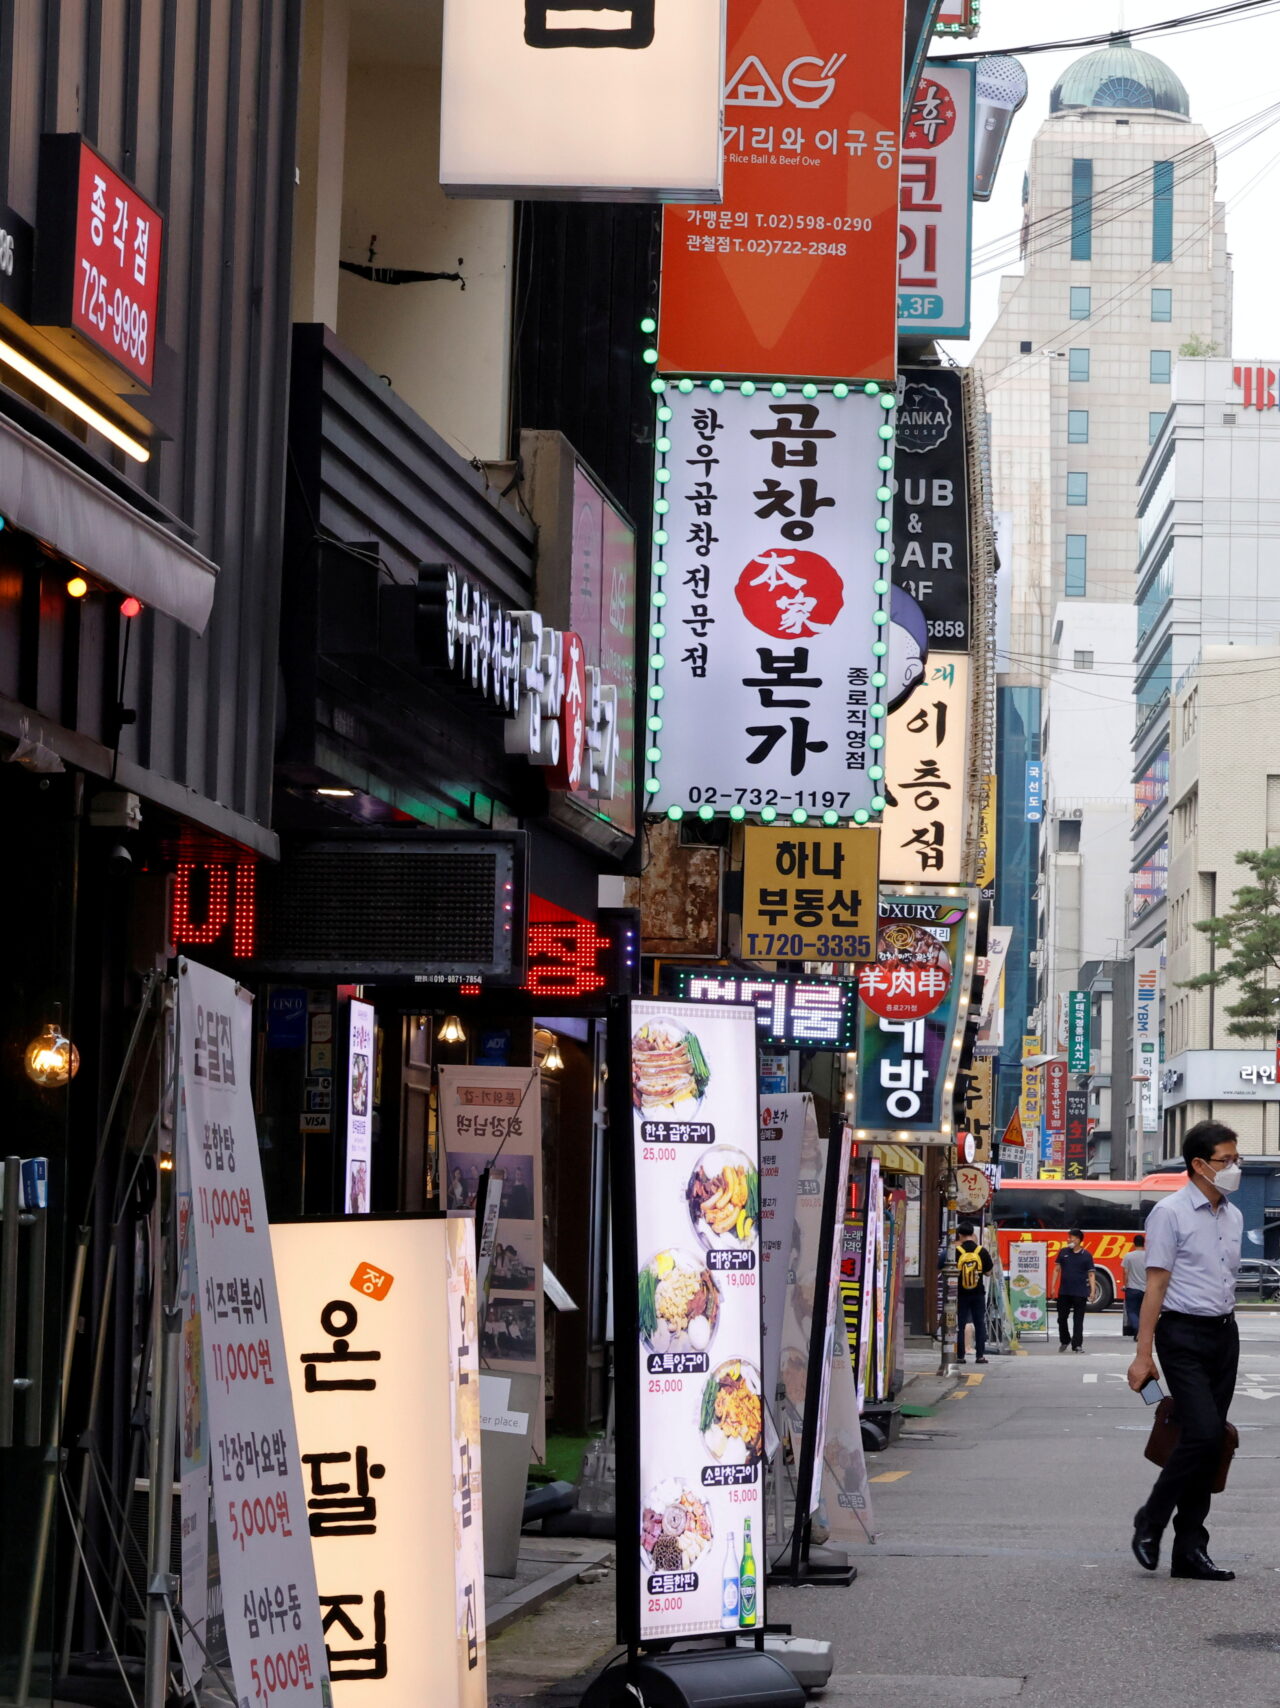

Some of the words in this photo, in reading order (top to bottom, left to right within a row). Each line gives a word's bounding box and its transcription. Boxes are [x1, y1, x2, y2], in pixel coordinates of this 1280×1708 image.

[729, 153, 749, 164] Rice
[751, 154, 769, 164] Ball
[770, 154, 778, 164] &
[779, 155, 801, 166] Beef
[814, 127, 897, 170] 이규동
[91, 173, 149, 287] 종각점
[687, 209, 749, 229] 가맹문의
[901, 155, 943, 289] 코인
[686, 234, 731, 253] 관철점
[80, 258, 149, 367] 725-9998
[750, 403, 837, 542] 곱창
[907, 512, 922, 534] &
[681, 407, 724, 678] 한우곱창전문점
[890, 541, 954, 570] AR
[748, 551, 832, 634] 本家
[741, 646, 829, 777] 본가
[845, 666, 870, 771] 종로직영점
[688, 786, 851, 809] 02-732-1197
[898, 700, 952, 873] 이층집
[775, 841, 846, 879] 하나
[757, 887, 862, 928] 부동산
[879, 904, 941, 921] UXURY
[747, 933, 872, 958] T.720-3335
[859, 966, 947, 999] 羊肉串
[1137, 1004, 1149, 1032] YBM
[194, 1004, 236, 1086] 온달집
[1240, 1065, 1276, 1085] 리안
[303, 1115, 327, 1127] VISA
[644, 1123, 667, 1141] 한우
[669, 1123, 711, 1143] 곱창구이
[203, 1119, 236, 1174] 홍합탕
[643, 1147, 676, 1162] 25,000
[198, 1186, 255, 1238] 11,000원
[710, 1251, 752, 1270] 대창구이
[726, 1272, 756, 1288] 19,000
[206, 1276, 268, 1325] 치즈떡볶이
[211, 1338, 275, 1395] 11,000원
[650, 1353, 708, 1373] 소특양구이
[648, 1379, 683, 1394] 25,000
[494, 1414, 522, 1430] place.
[218, 1428, 288, 1483] 간장마요밥
[300, 1299, 388, 1682] 온달집
[703, 1464, 756, 1486] 소막창구이
[727, 1488, 758, 1504] 15,000
[229, 1490, 293, 1552] 5,000원
[651, 1574, 695, 1594] 모듬한판
[243, 1582, 301, 1639] 심야우동
[648, 1597, 683, 1615] 25,000
[249, 1643, 315, 1708] 5,000원
